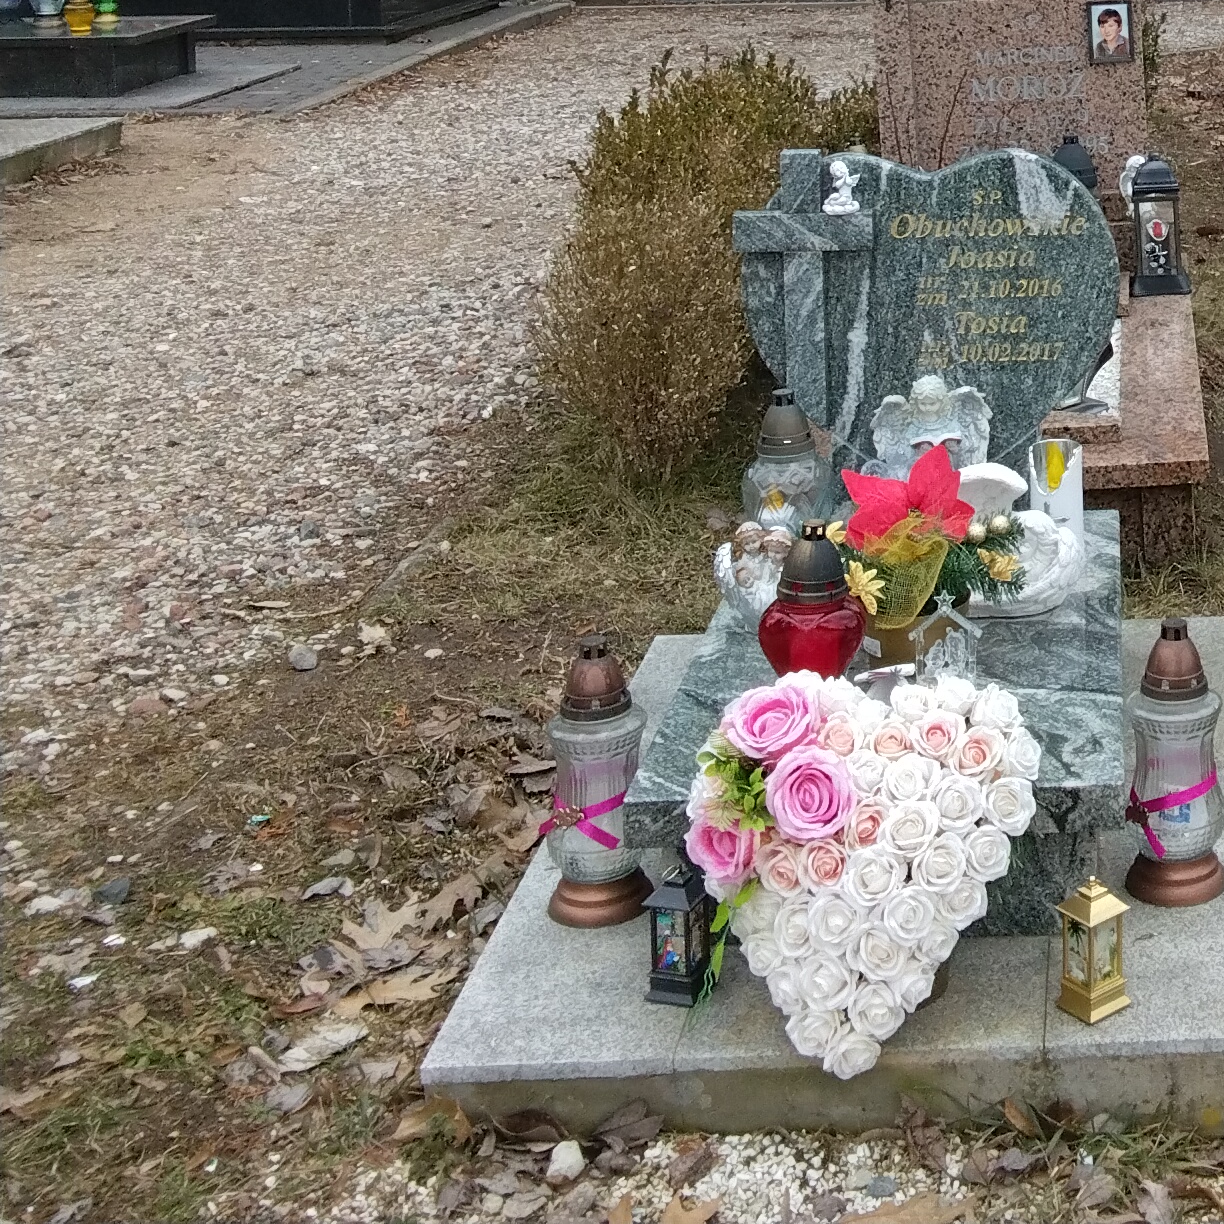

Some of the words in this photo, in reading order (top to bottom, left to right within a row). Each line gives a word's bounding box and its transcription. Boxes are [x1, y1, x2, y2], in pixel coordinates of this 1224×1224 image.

[975, 45, 1081, 66] MARCINEK
[889, 211, 1086, 239] Obuchowskie
[943, 243, 1036, 270] Joasia
[956, 276, 1063, 299] 21.10.2016
[954, 310, 1029, 335] Tosia
[961, 341, 1065, 363] 10.02.2017
